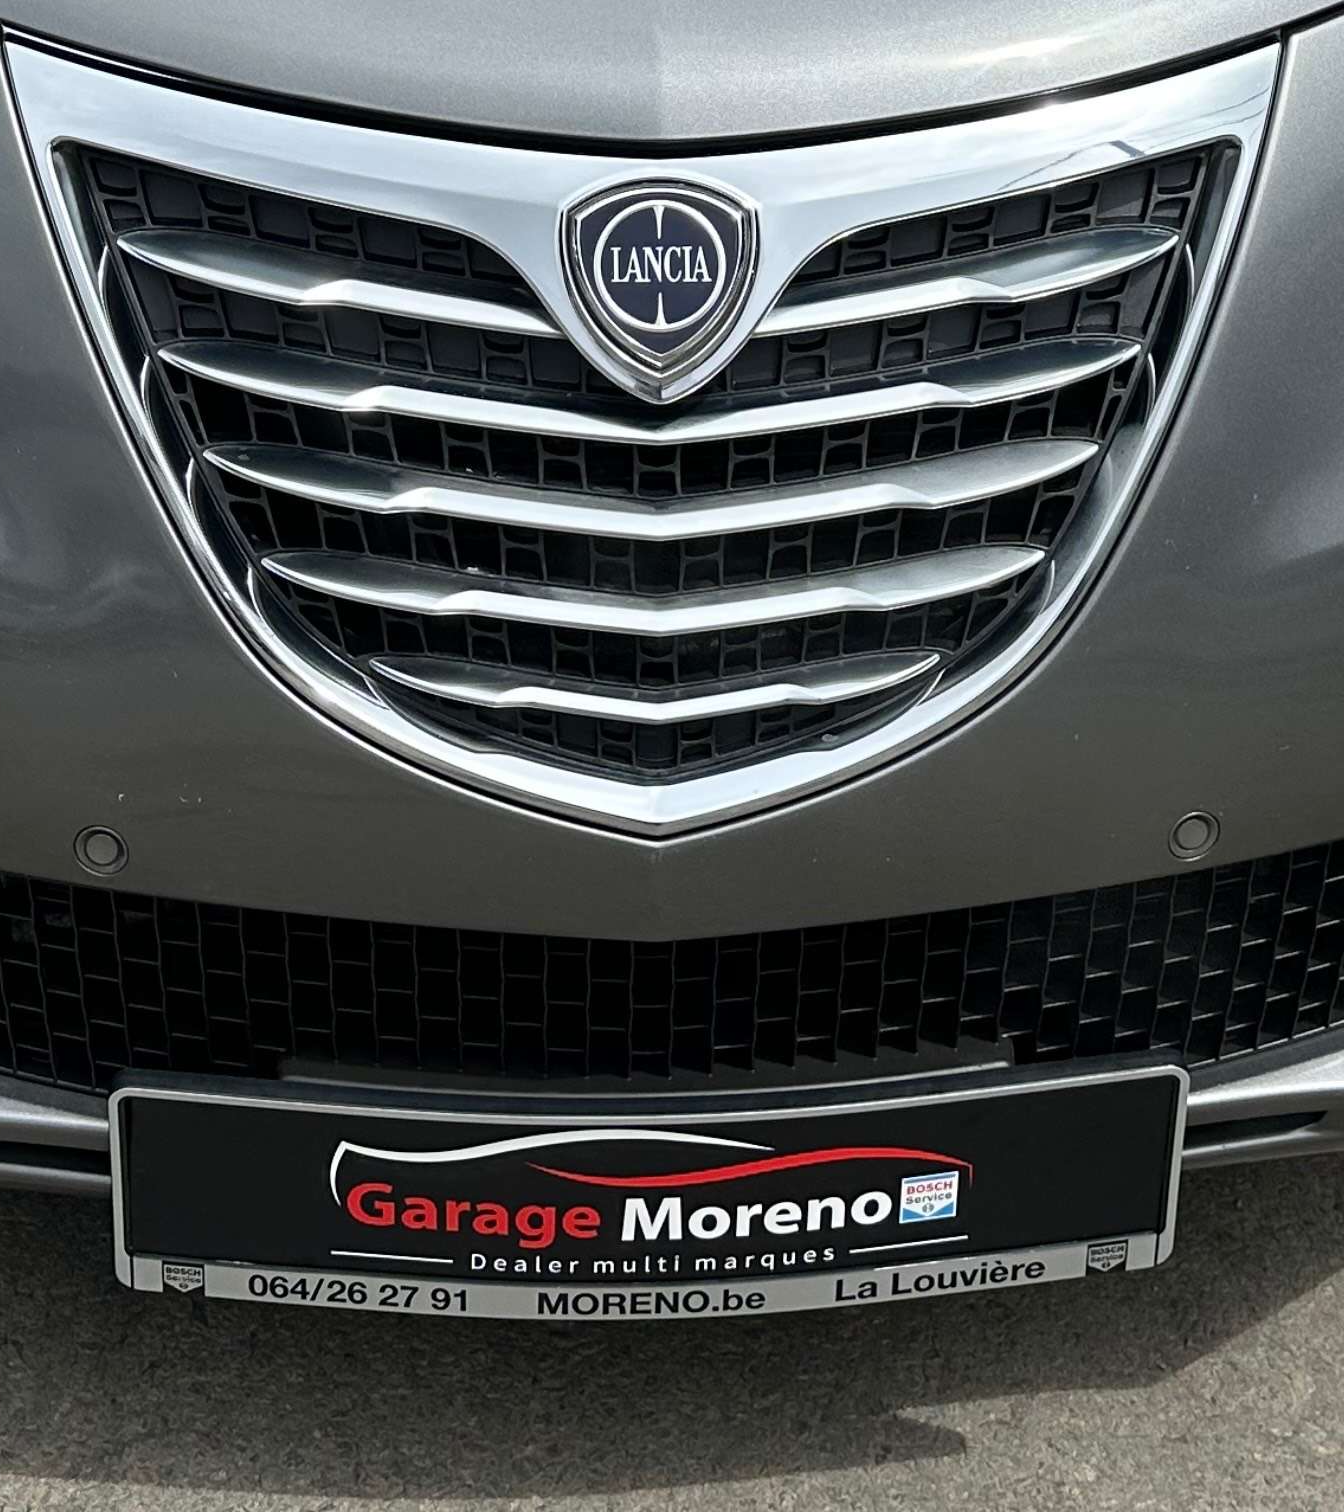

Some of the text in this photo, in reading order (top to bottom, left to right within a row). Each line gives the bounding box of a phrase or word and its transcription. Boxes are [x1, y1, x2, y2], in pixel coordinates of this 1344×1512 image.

[610, 245, 712, 283] LANCIA
[906, 1180, 953, 1195] BOSCH
[906, 1191, 952, 1205] Service
[346, 1182, 893, 1249] Garage Moreno
[471, 1246, 834, 1274] Dealer multi marques
[248, 1274, 467, 1312] 064/26 27 91
[835, 1260, 1046, 1302] La Louvière
[537, 1289, 766, 1315] MORENO.be
